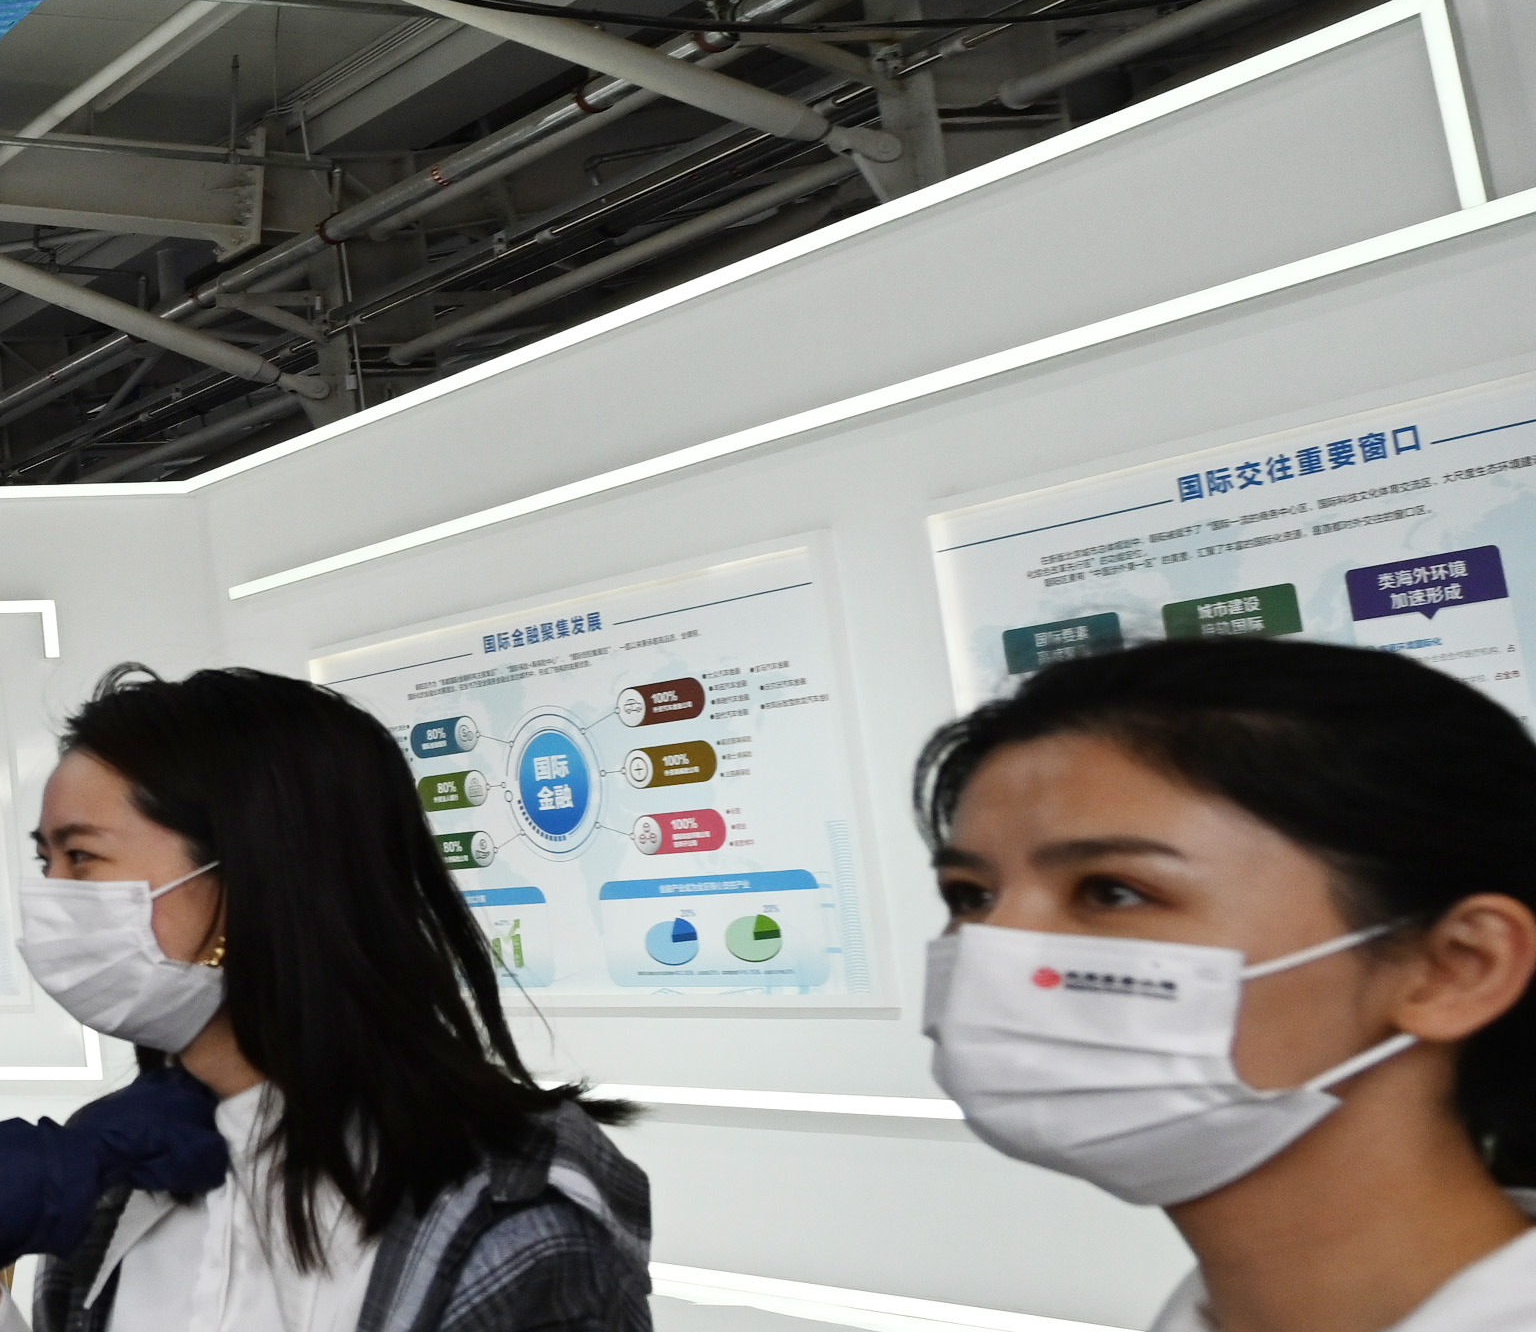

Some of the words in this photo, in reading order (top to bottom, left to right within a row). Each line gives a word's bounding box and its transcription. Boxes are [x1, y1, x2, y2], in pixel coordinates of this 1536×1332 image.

[1177, 424, 1422, 503] 国际交往重要窗口
[1377, 560, 1469, 591] 类海外环境
[1389, 583, 1464, 611] 加速形成
[482, 611, 603, 654] 国际金融聚集发展
[651, 690, 678, 704] 100%
[426, 727, 446, 740] 80%
[533, 754, 571, 781] 国际
[662, 753, 690, 766] 100%
[437, 780, 457, 794] 80%
[536, 784, 574, 810] 金融
[670, 817, 698, 830] 100%
[443, 840, 463, 853] 80%
